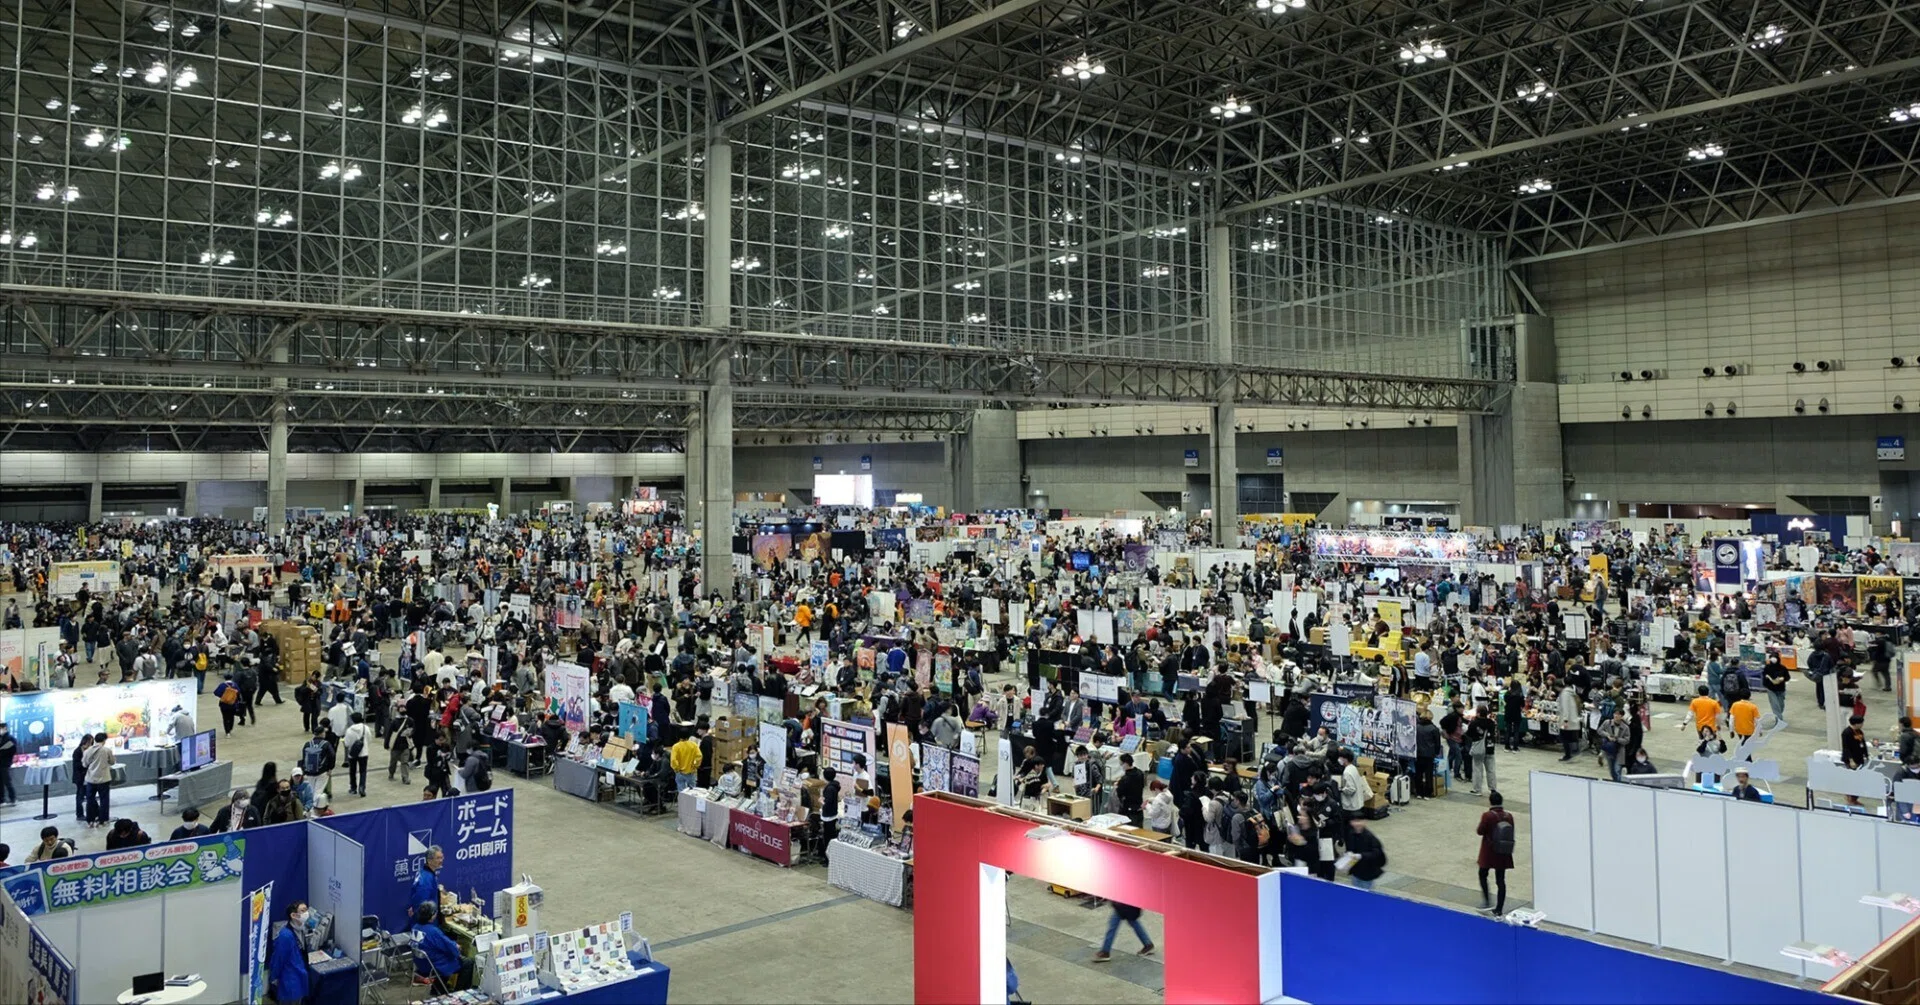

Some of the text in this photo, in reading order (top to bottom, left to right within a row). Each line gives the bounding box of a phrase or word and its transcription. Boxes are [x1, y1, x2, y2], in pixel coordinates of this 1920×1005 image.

[1893, 439, 1900, 447] 4
[1859, 578, 1900, 588] MAGAZINE
[457, 794, 509, 821] ボード
[457, 818, 508, 844] ゲーム
[734, 822, 784, 850] MIRROR HOUSE
[455, 838, 508, 860] の印刷所
[11, 885, 39, 899] ゲーム
[52, 860, 194, 907] 無料相談会
